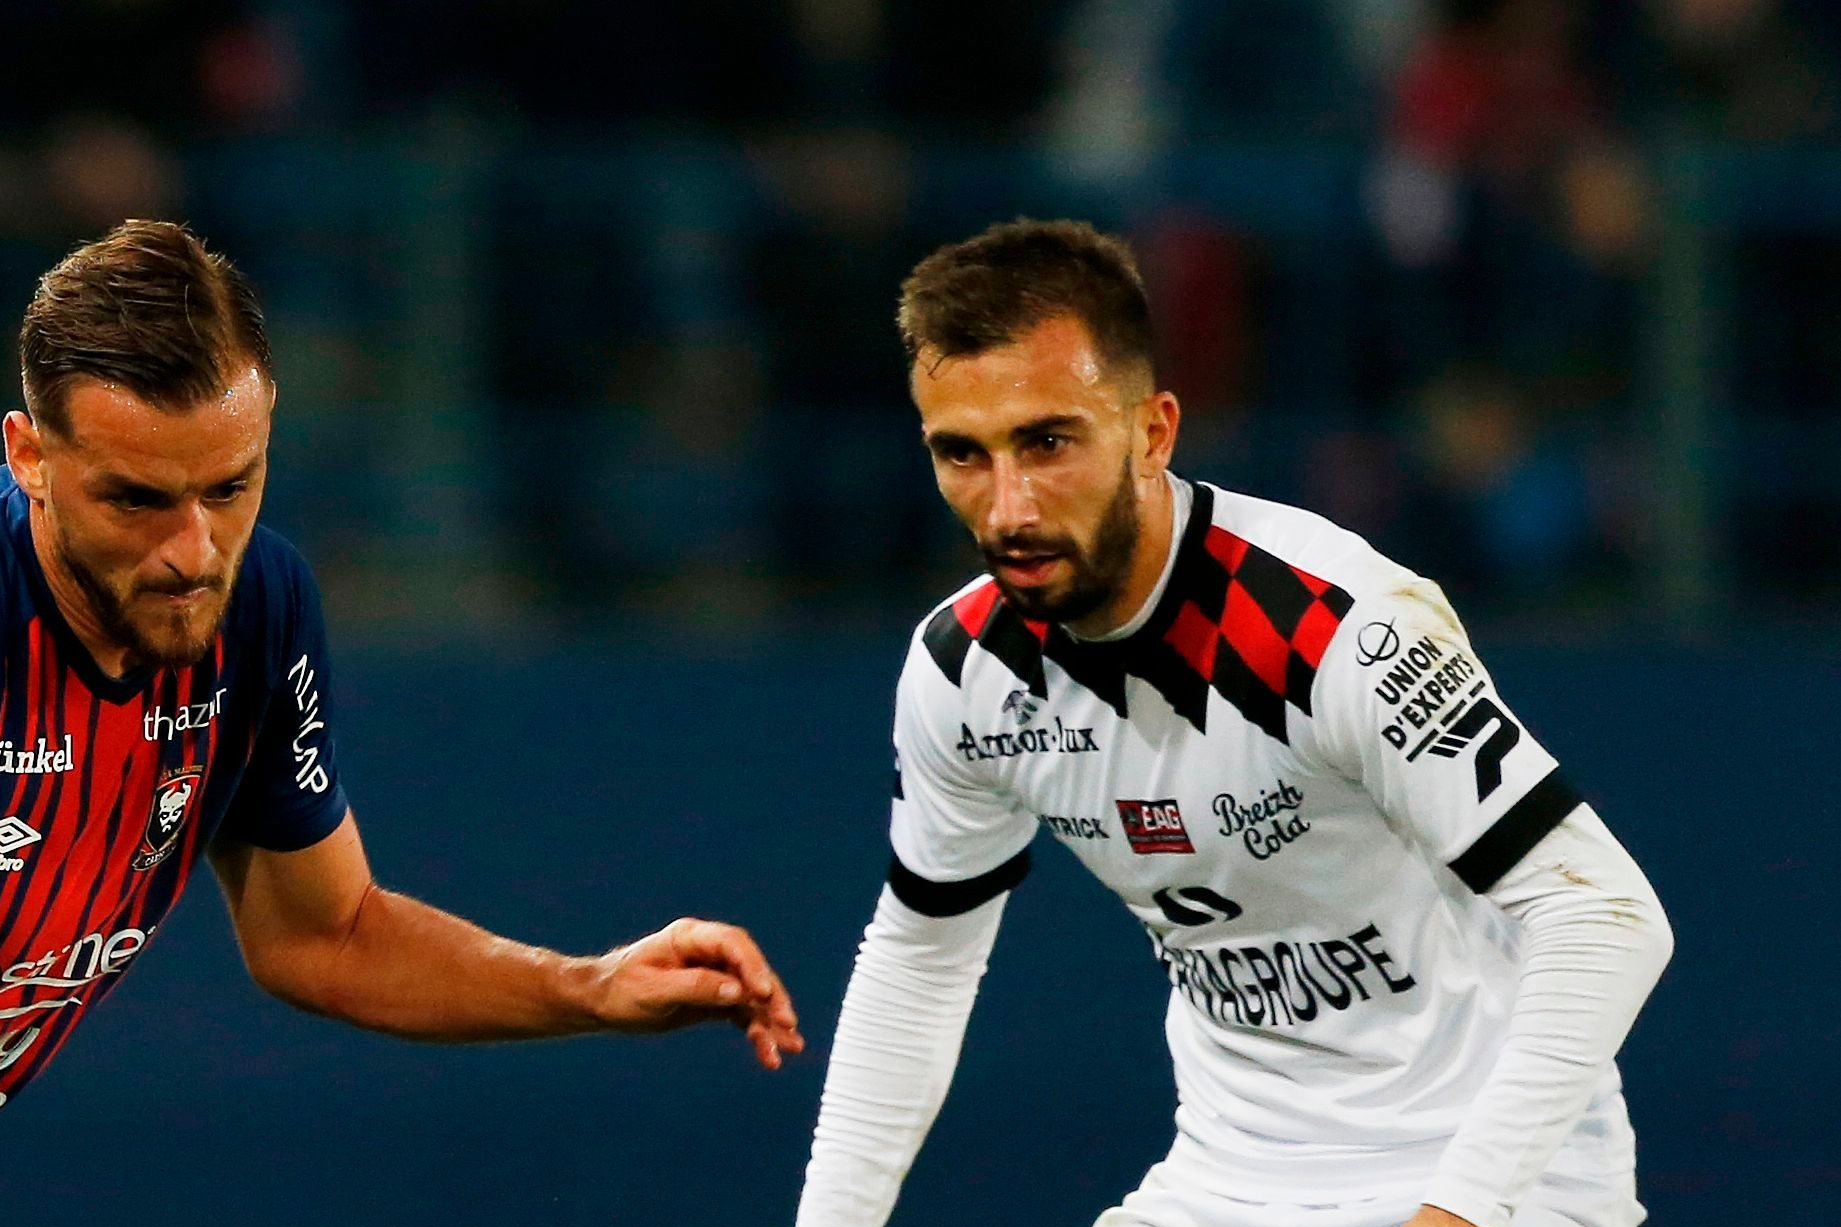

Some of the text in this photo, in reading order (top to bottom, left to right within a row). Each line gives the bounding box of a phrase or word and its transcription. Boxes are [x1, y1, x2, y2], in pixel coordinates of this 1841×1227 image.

[1375, 636, 1444, 705] UNION
[1381, 653, 1475, 750] D'EXPERTS
[1141, 804, 1181, 831] EAG
[1212, 778, 1304, 837] Breizh
[1243, 814, 1311, 861] Cola
